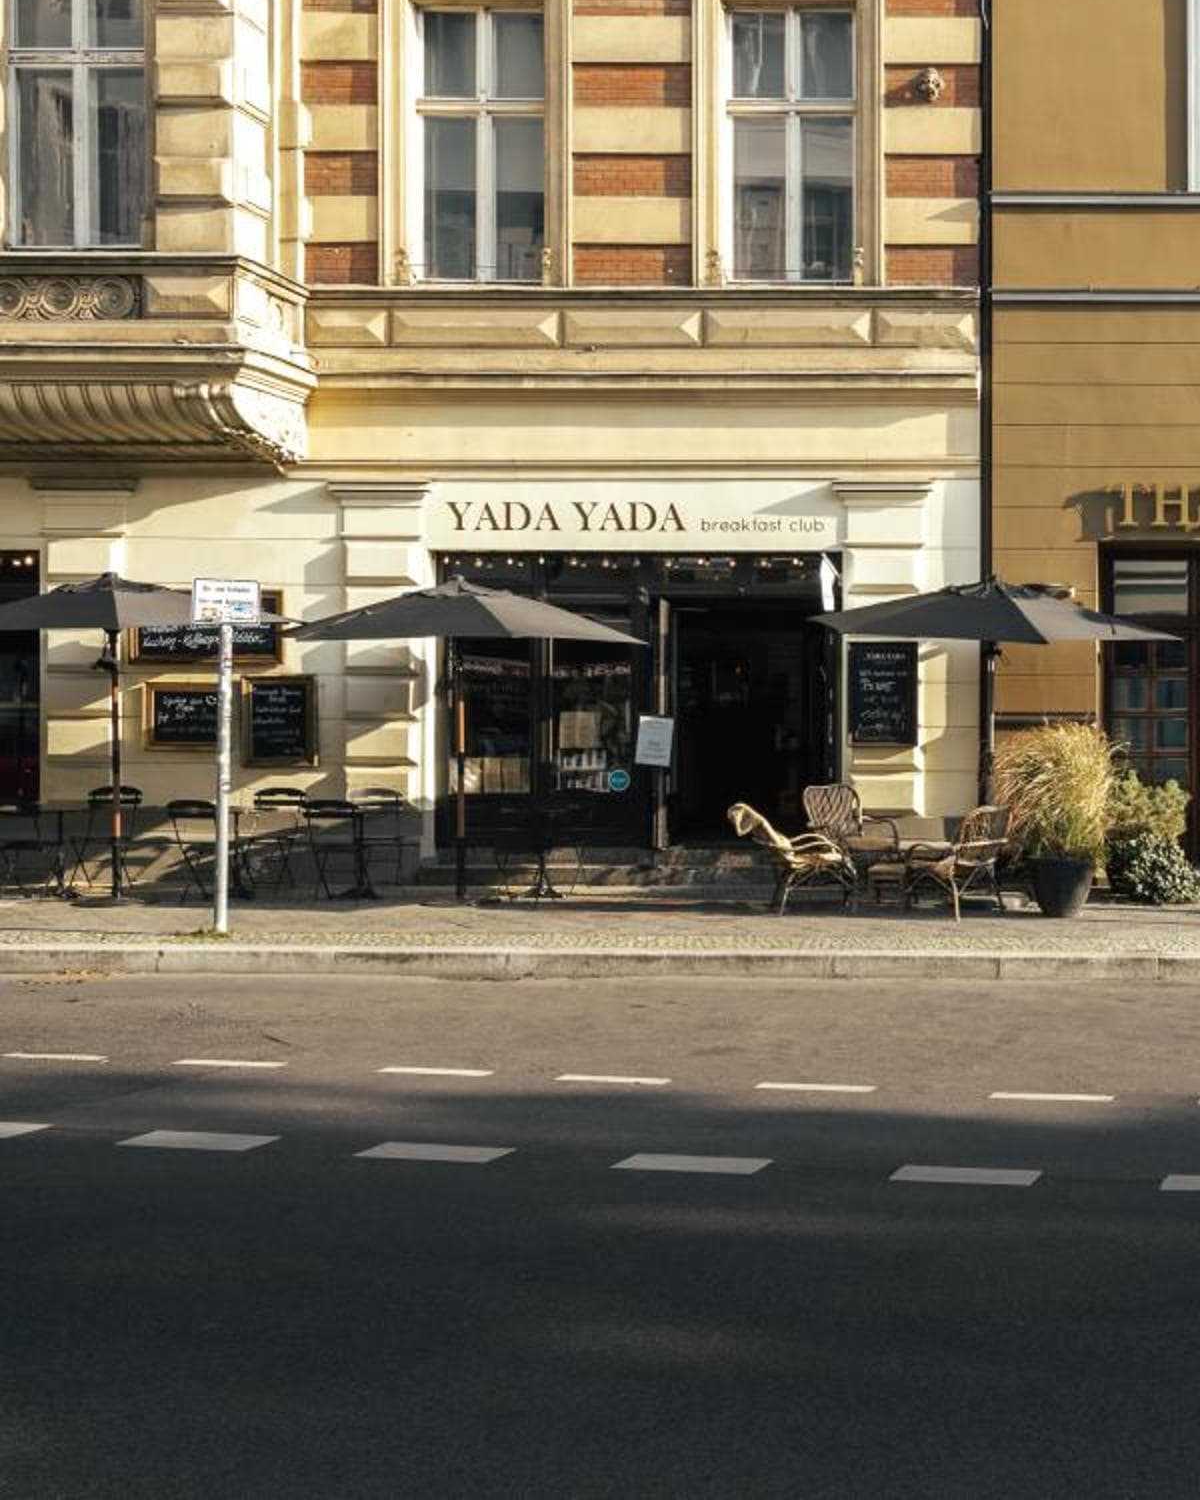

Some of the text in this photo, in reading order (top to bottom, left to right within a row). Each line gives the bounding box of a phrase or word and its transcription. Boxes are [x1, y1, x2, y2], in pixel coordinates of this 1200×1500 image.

[446, 501, 825, 533] YADA YADA breakfast club
